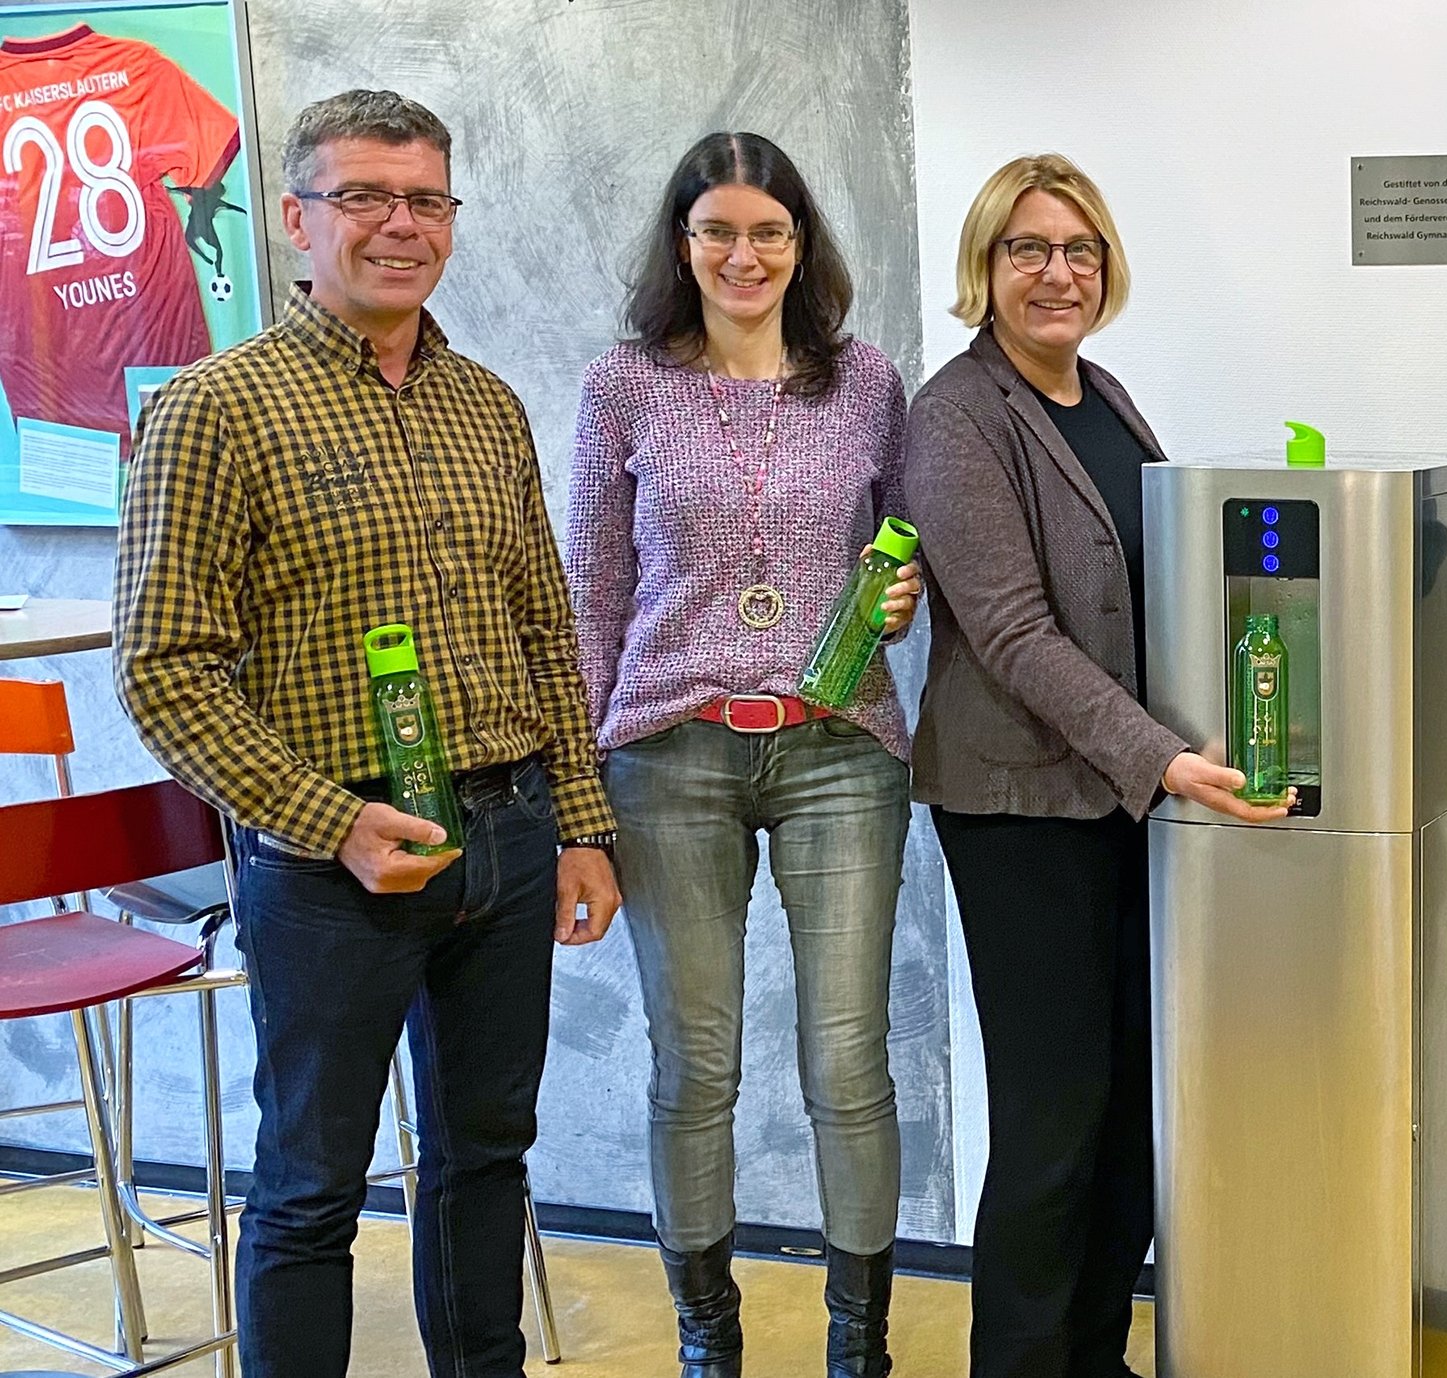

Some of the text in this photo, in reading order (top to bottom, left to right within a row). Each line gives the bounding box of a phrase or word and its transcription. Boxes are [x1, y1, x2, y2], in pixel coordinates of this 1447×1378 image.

[14, 71, 129, 108] KAISERSLAUTERN
[2, 100, 147, 275] 28
[1383, 179, 1421, 189] Gestiftet
[1359, 197, 1411, 206] Reichswald-
[1364, 215, 1381, 223] und
[1367, 231, 1414, 240] Reichswald
[52, 271, 137, 310] YOUNES
